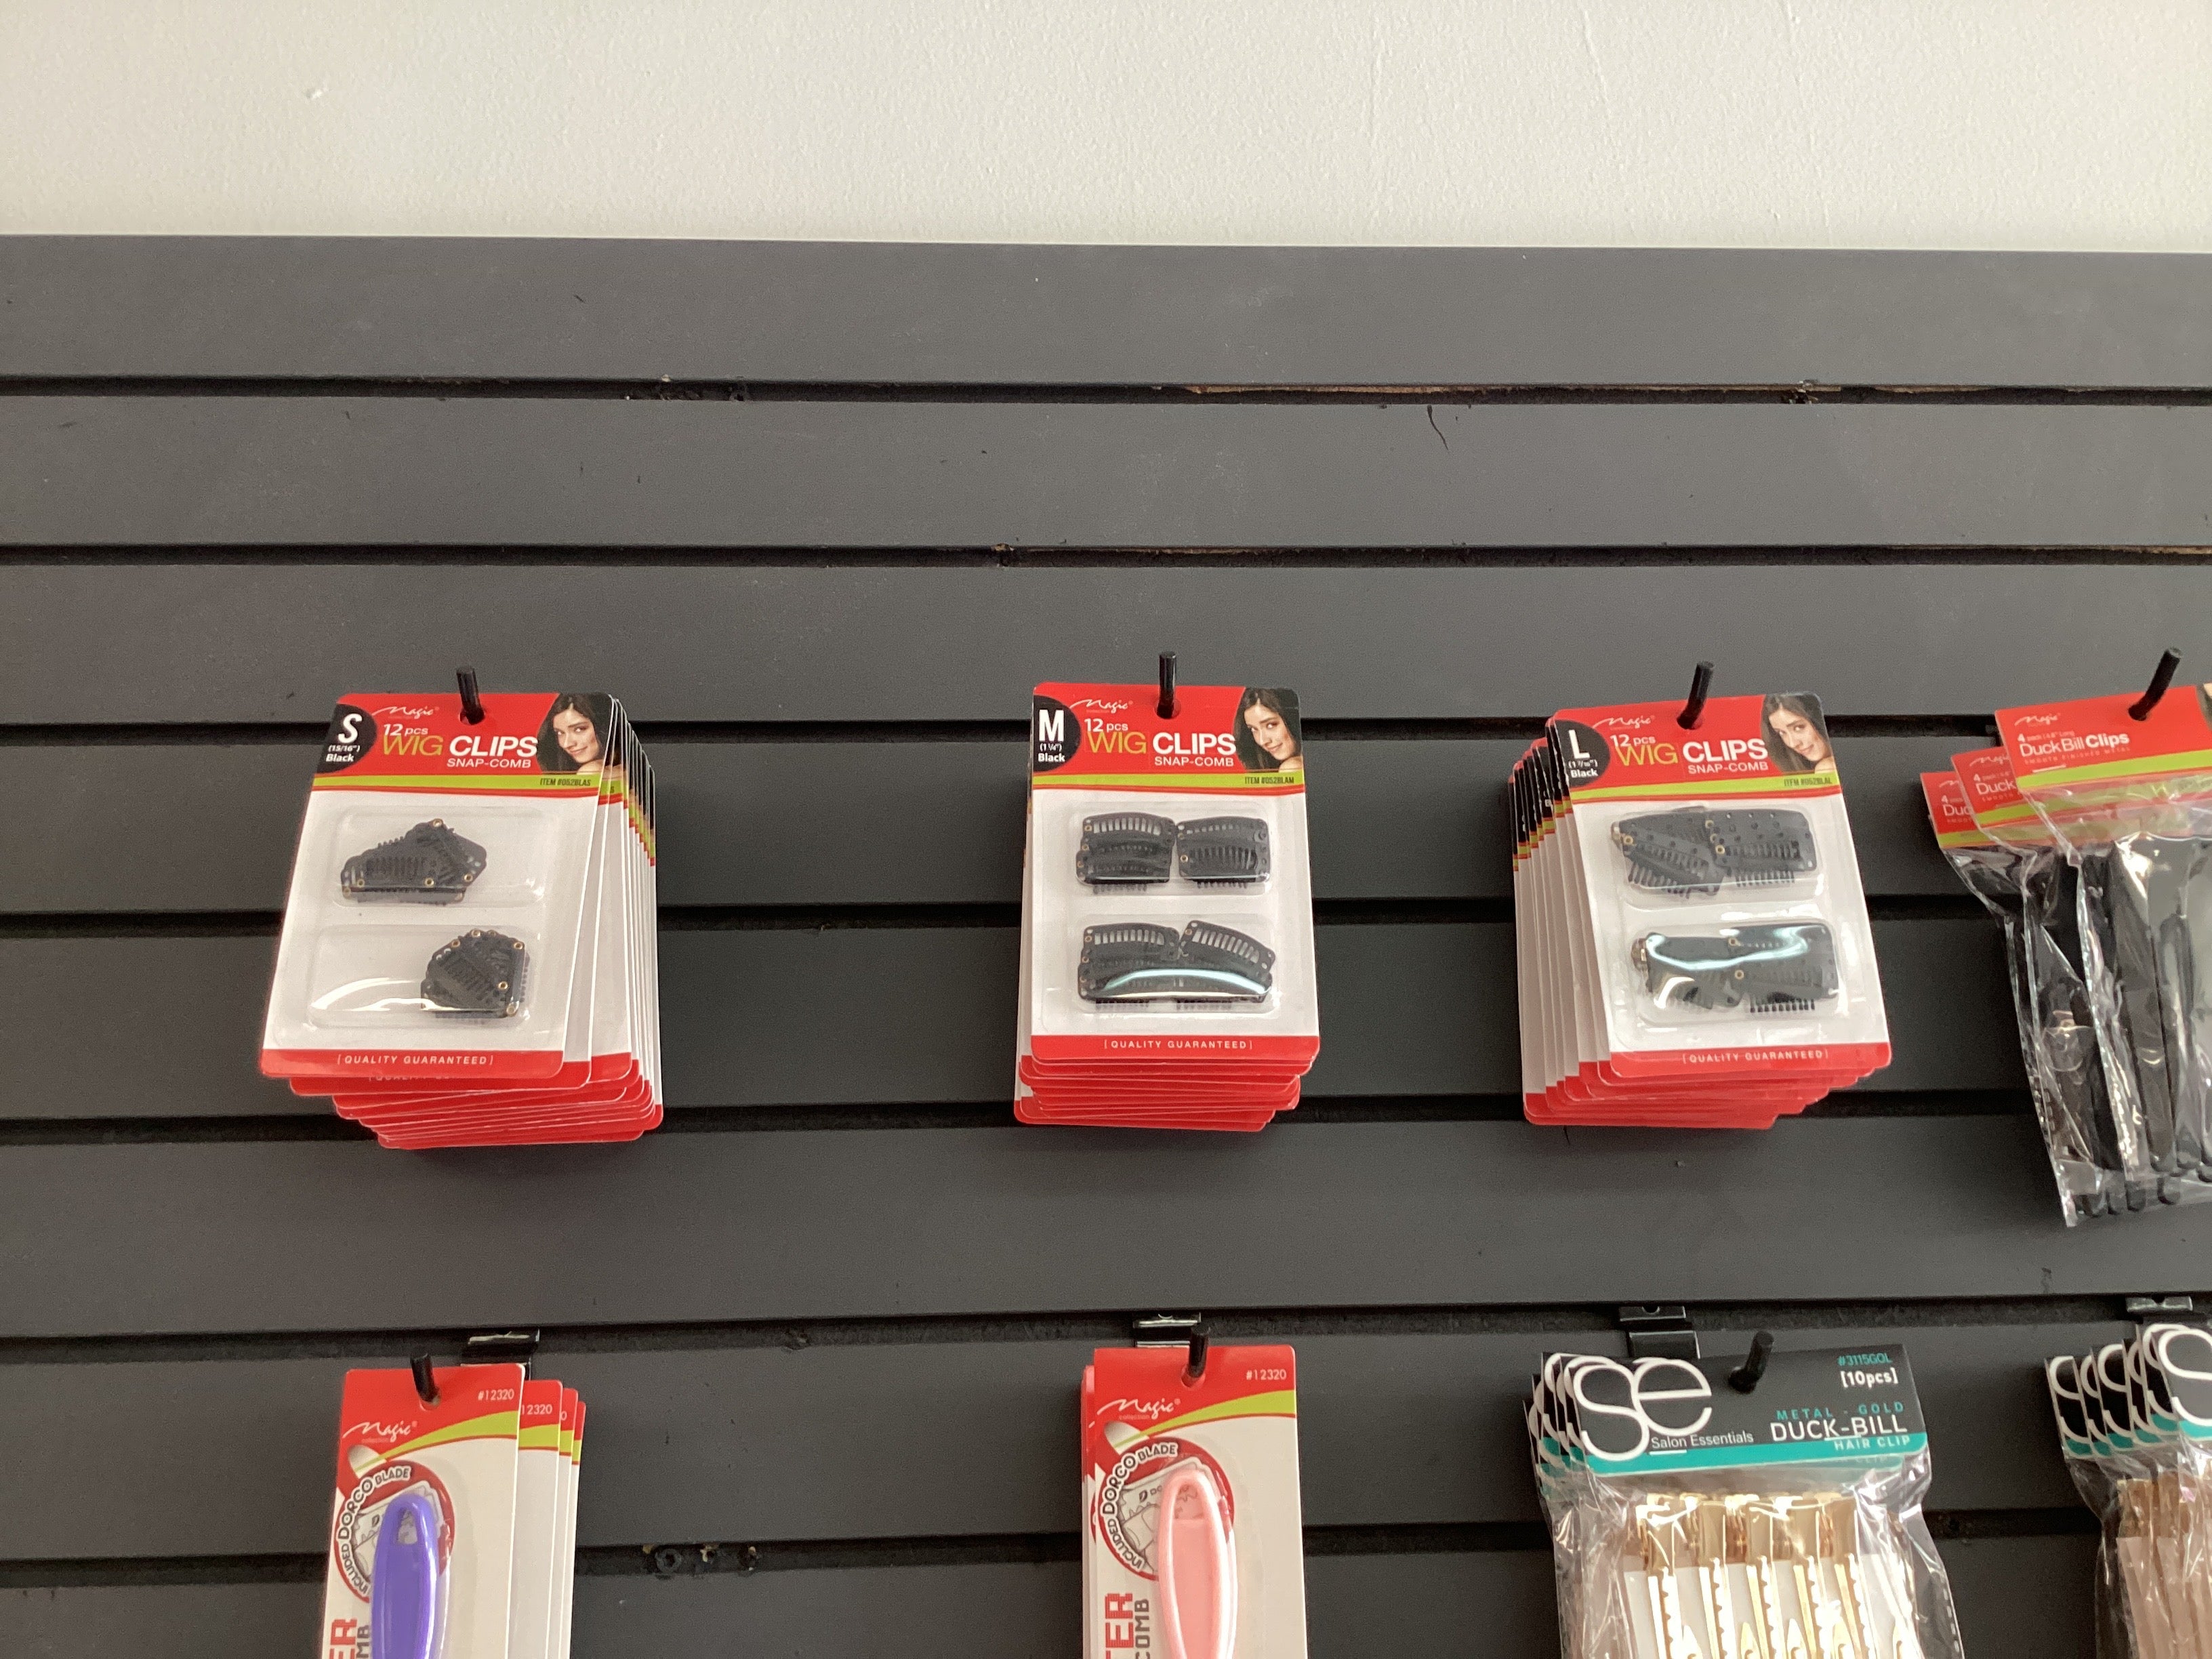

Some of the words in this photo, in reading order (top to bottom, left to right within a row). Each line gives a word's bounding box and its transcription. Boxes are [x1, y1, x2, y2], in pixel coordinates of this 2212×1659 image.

[338, 714, 363, 743] S
[383, 723, 402, 736] 12
[404, 727, 429, 737] pcs
[1038, 709, 1065, 742] M
[1084, 718, 1104, 732] 12
[1106, 722, 1128, 733] pcs
[382, 735, 444, 756] WIG
[449, 735, 539, 758] CLIPS
[1087, 731, 1147, 754] WIG
[1153, 732, 1237, 756] CLIPS
[1568, 729, 1591, 759] L
[1610, 734, 1631, 747] 12
[1633, 736, 1656, 746] pcs
[2018, 733, 2026, 743] 4
[2085, 733, 2129, 748] Clips
[325, 753, 354, 762] Black
[1038, 752, 1065, 762] Black
[1616, 743, 1678, 766] WIG
[1683, 738, 1768, 762] CLIPS
[447, 758, 532, 769] SNAP-COMB
[1154, 756, 1234, 766] SNAP-COMB
[1687, 762, 1769, 774] SNAP-COMB
[1570, 768, 1599, 778] Black
[540, 778, 556, 786] ITEM
[1975, 779, 2016, 795] Duck
[1246, 1369, 1287, 1380] #12320
[1840, 1367, 1899, 1389] [10pcs]
[478, 1389, 515, 1401] #12320
[521, 1404, 553, 1415] 12320
[1097, 1397, 1174, 1420] Magic
[1776, 1408, 1833, 1420] METAL
[1858, 1401, 1904, 1415] GOLD
[342, 1420, 411, 1443] Magic
[1770, 1414, 1908, 1441] DUCK-BILL
[1651, 1435, 1687, 1448] Salon
[1690, 1430, 1754, 1446] Essentials
[1833, 1438, 1870, 1450] HAIR
[1877, 1435, 1910, 1446] CLIP
[1138, 1444, 1176, 1461] BLADE
[375, 1468, 409, 1485] BLADE
[1103, 1455, 1136, 1514] DORCO
[338, 1479, 373, 1540] DORCO
[1107, 1519, 1142, 1570] INCLUDED
[342, 1544, 369, 1595] INCLUDED
